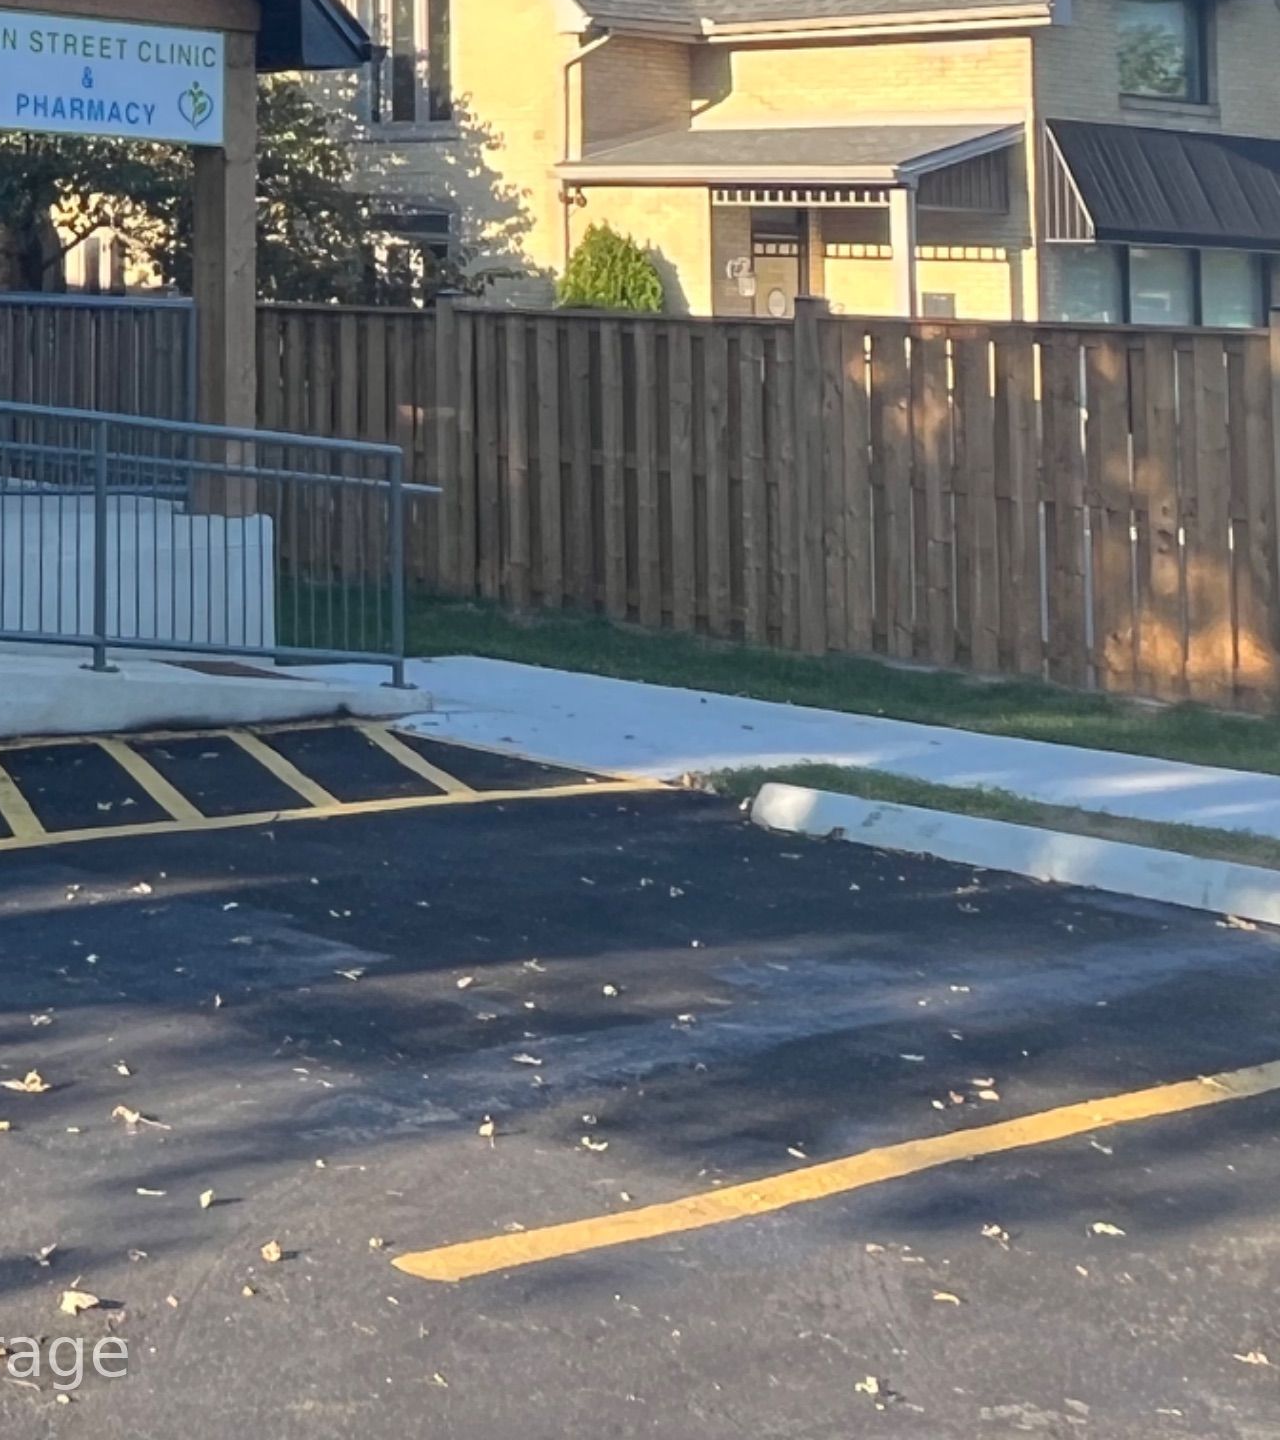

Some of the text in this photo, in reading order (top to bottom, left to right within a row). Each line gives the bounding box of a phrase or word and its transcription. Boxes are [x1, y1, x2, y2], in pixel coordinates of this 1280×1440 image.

[29, 29, 128, 60] STREET
[137, 40, 218, 68] CLINIC
[81, 66, 94, 88] &
[16, 93, 156, 126] PHARMACY
